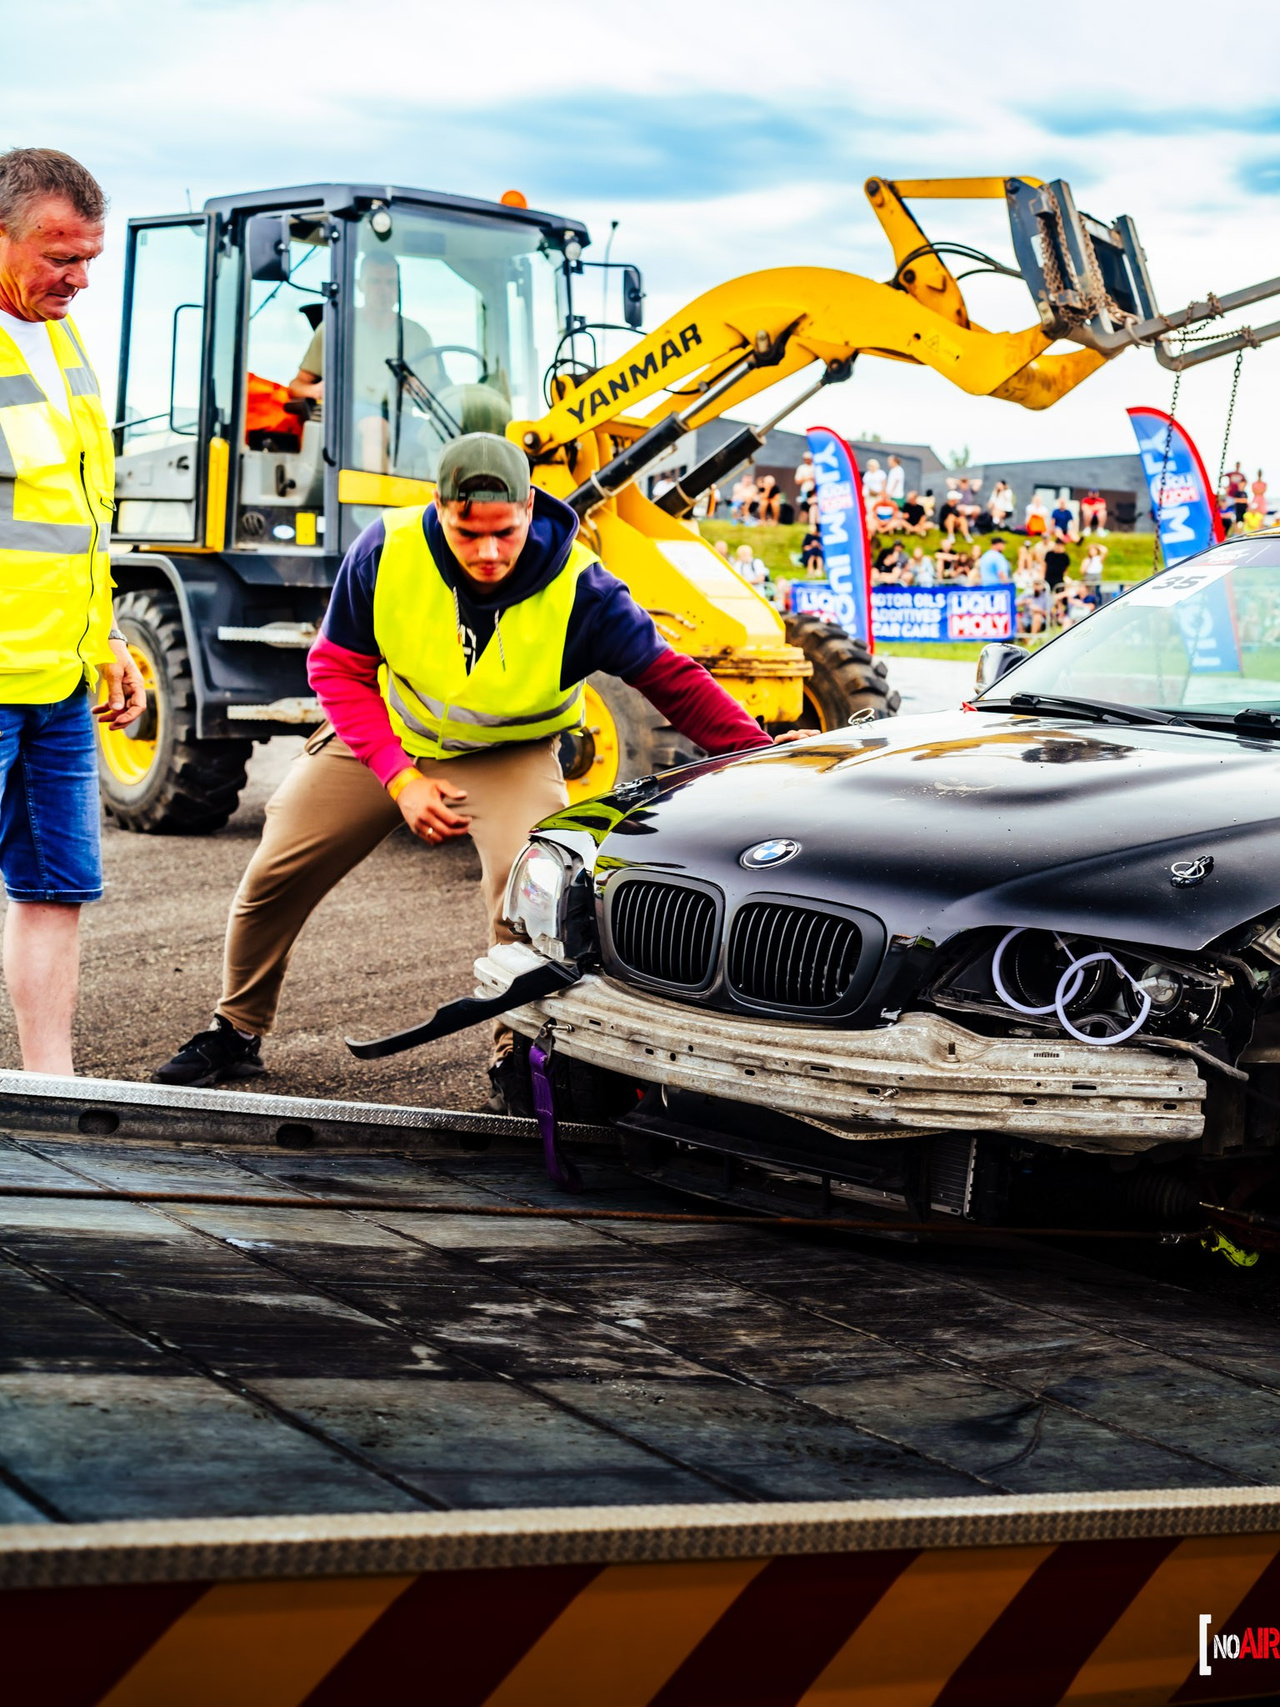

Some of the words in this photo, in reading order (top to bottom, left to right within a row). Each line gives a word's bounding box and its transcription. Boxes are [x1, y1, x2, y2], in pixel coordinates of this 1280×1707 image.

[566, 323, 703, 424] YANMAR
[1151, 576, 1207, 590] 35
[913, 593, 946, 609] OILS
[951, 593, 1007, 614] LIQUI
[901, 622, 940, 638] CARE
[952, 614, 1008, 636] MOLY
